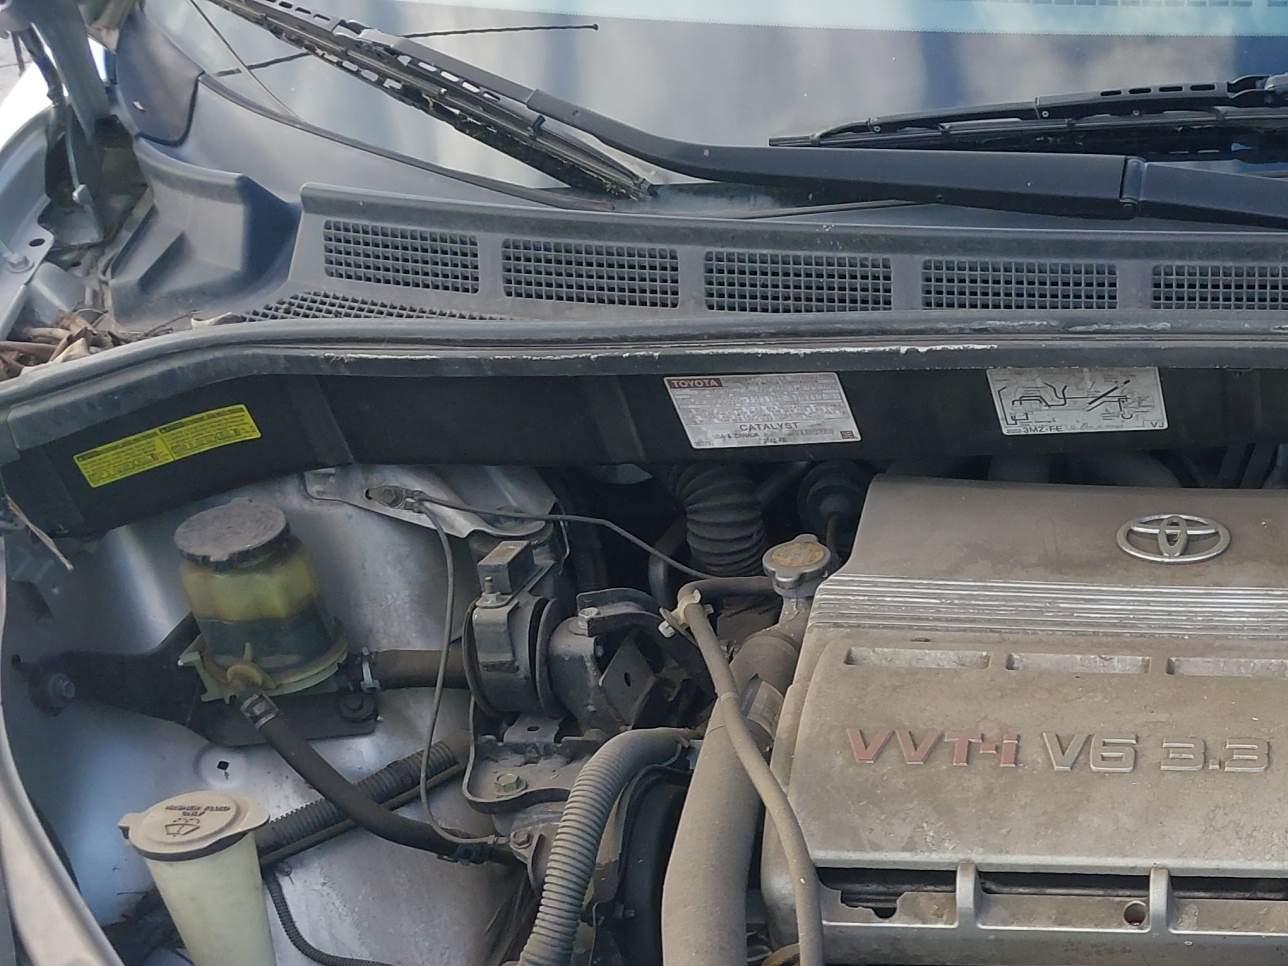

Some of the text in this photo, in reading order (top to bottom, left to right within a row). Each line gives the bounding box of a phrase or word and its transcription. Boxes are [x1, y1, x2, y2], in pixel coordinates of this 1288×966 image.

[671, 379, 719, 388] TOYOTA
[739, 422, 799, 432] CATALYST
[1042, 731, 1138, 772] V6
[1160, 736, 1271, 772] 3.3
